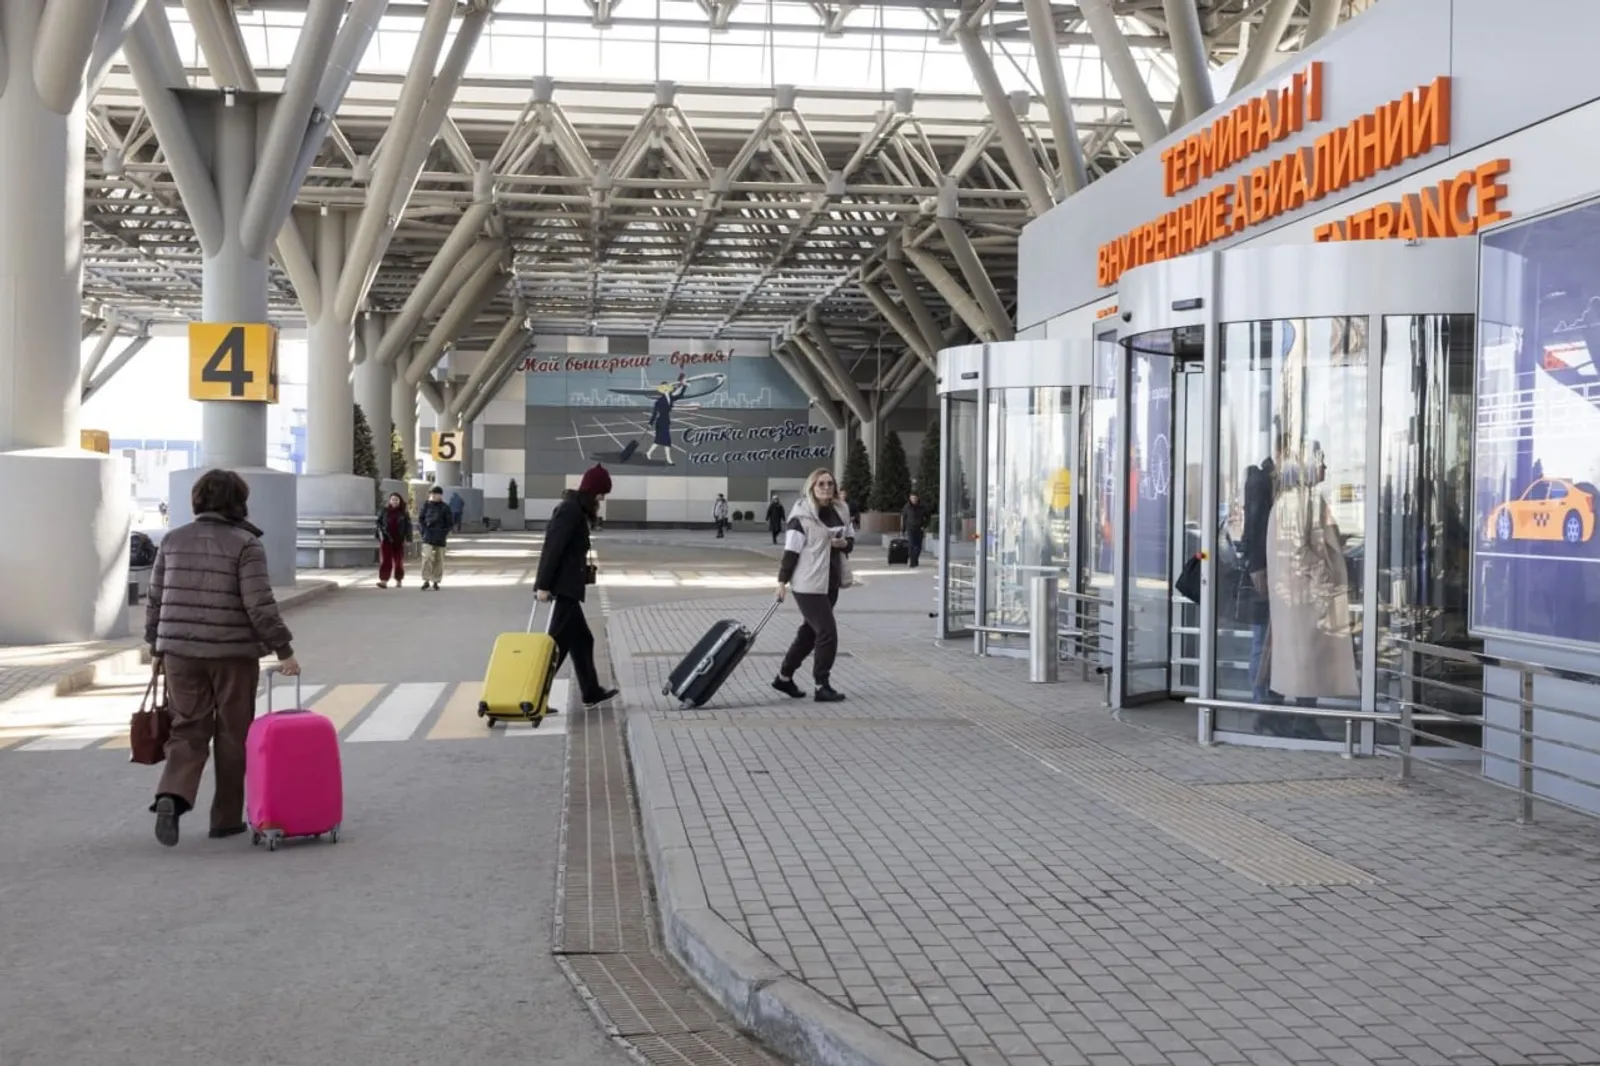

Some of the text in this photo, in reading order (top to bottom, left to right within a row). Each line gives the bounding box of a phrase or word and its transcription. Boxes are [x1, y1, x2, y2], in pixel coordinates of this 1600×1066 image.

[1161, 72, 1303, 196] ТЕРМИНАЛ
[1097, 76, 1450, 287] ВНУТРЕННИЕ АВИАЛИНИИ
[202, 326, 254, 397] 4
[565, 354, 652, 374] выигрыш
[670, 348, 735, 369] время!
[437, 432, 456, 460] 5
[683, 426, 743, 446] Сутки
[688, 451, 720, 464] час
